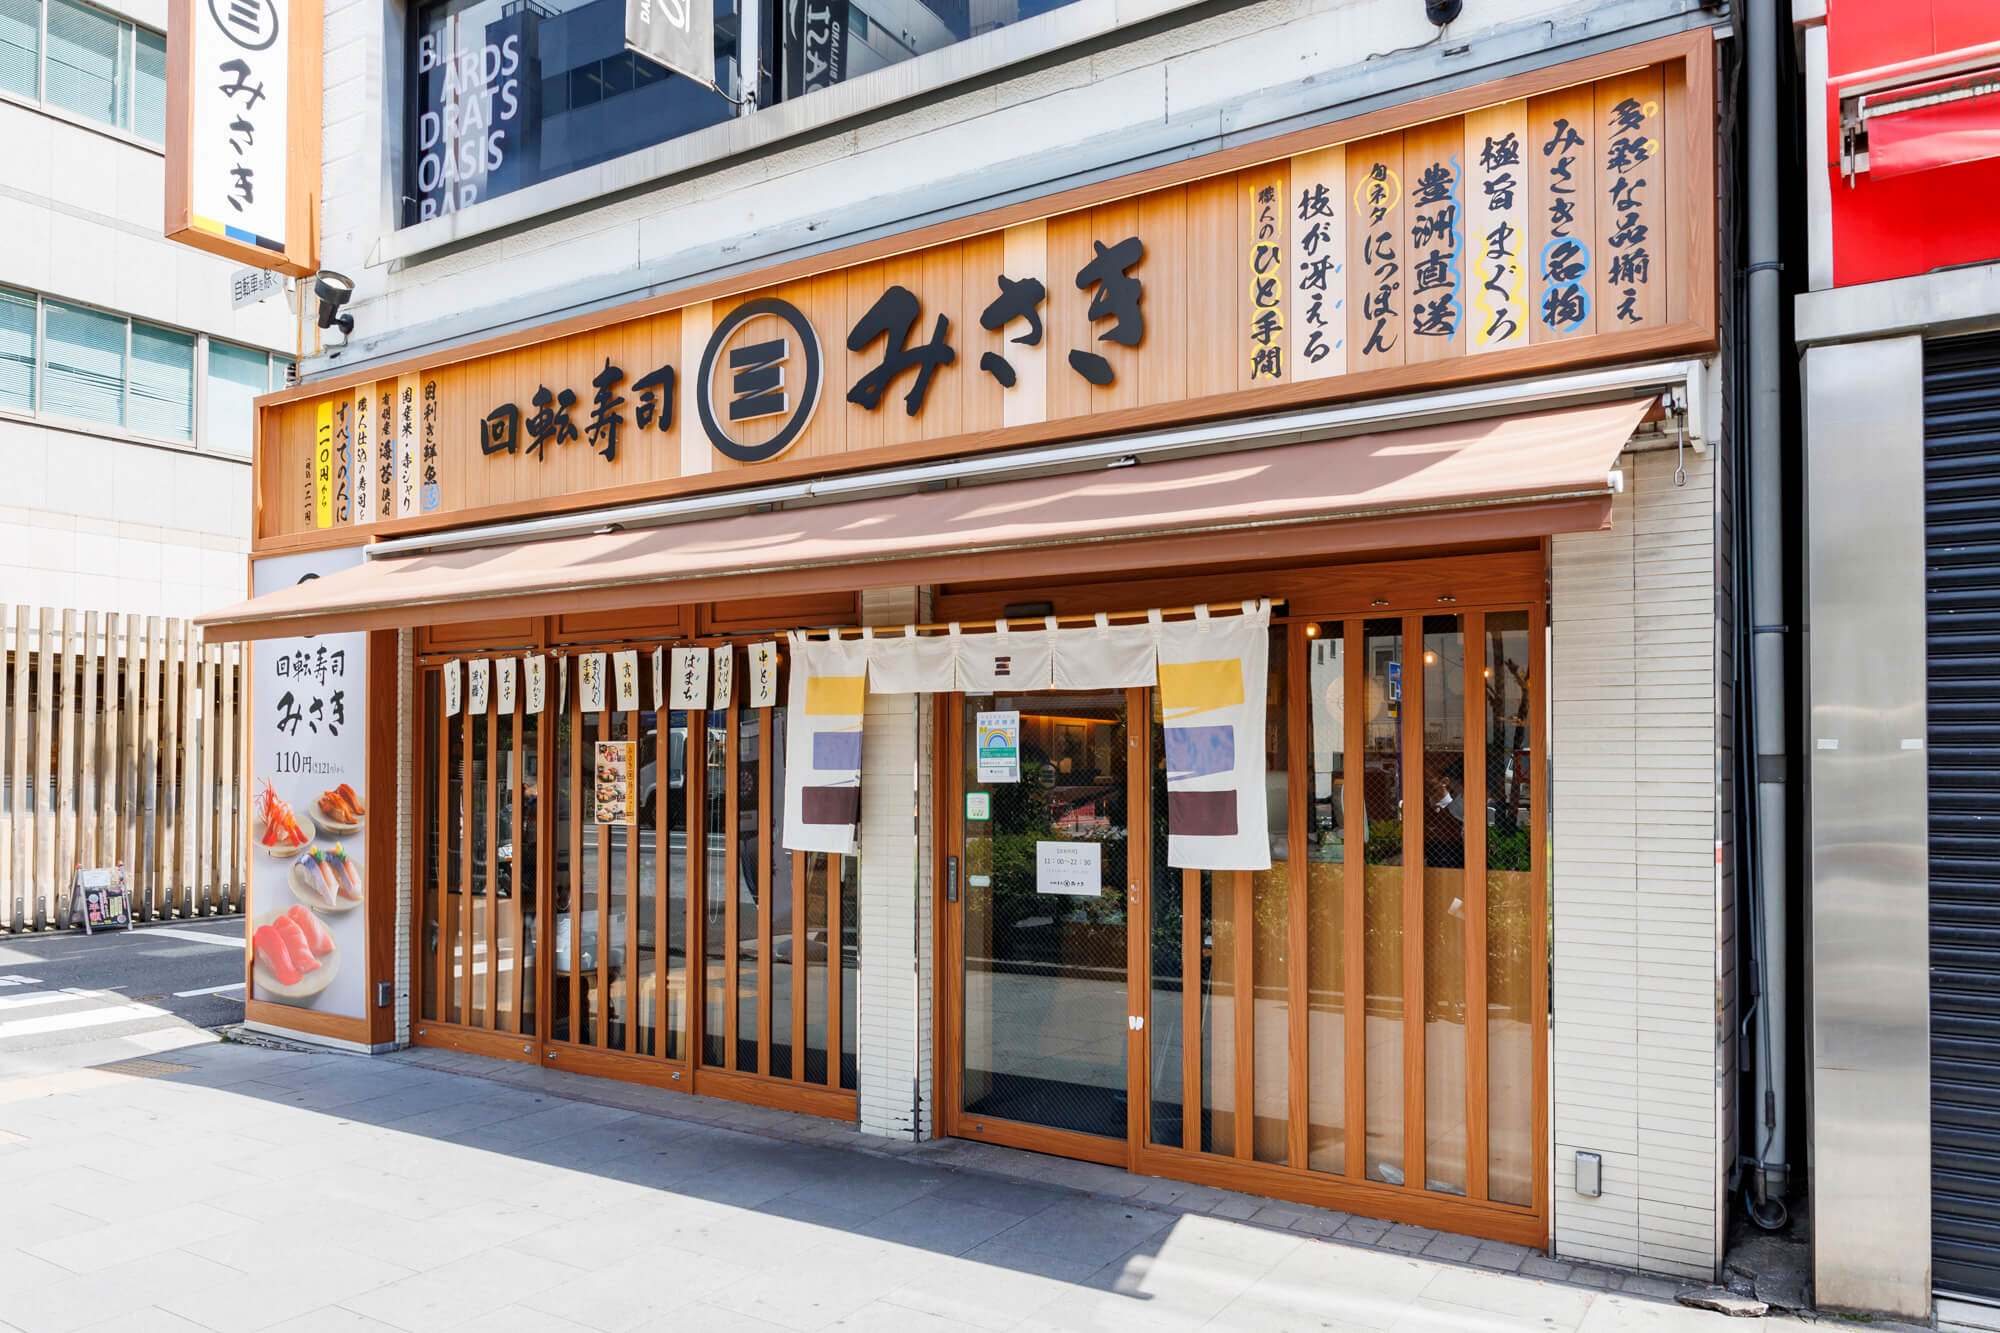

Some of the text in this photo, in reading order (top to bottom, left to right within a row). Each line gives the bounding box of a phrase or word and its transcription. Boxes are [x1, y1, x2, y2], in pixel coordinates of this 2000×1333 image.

[218, 58, 266, 213] みさき
[418, 130, 504, 192] OASIS
[1542, 118, 1586, 327] みさき名物
[1606, 97, 1650, 324] 多彩な品揃え
[1250, 184, 1284, 380] 職人のひと手間
[1297, 183, 1335, 364] 技が冴える
[1362, 162, 1400, 355] 旬ネタにっぽん
[1411, 161, 1457, 337] 豊洲直送
[1479, 131, 1521, 343] 極旨まぐろ
[480, 356, 675, 463] 回転寿司
[845, 235, 1143, 417] みさき
[276, 641, 345, 687] 回転寿司
[276, 689, 345, 737] みさき
[683, 653, 696, 701] はまち
[758, 649, 768, 700] 中とろ
